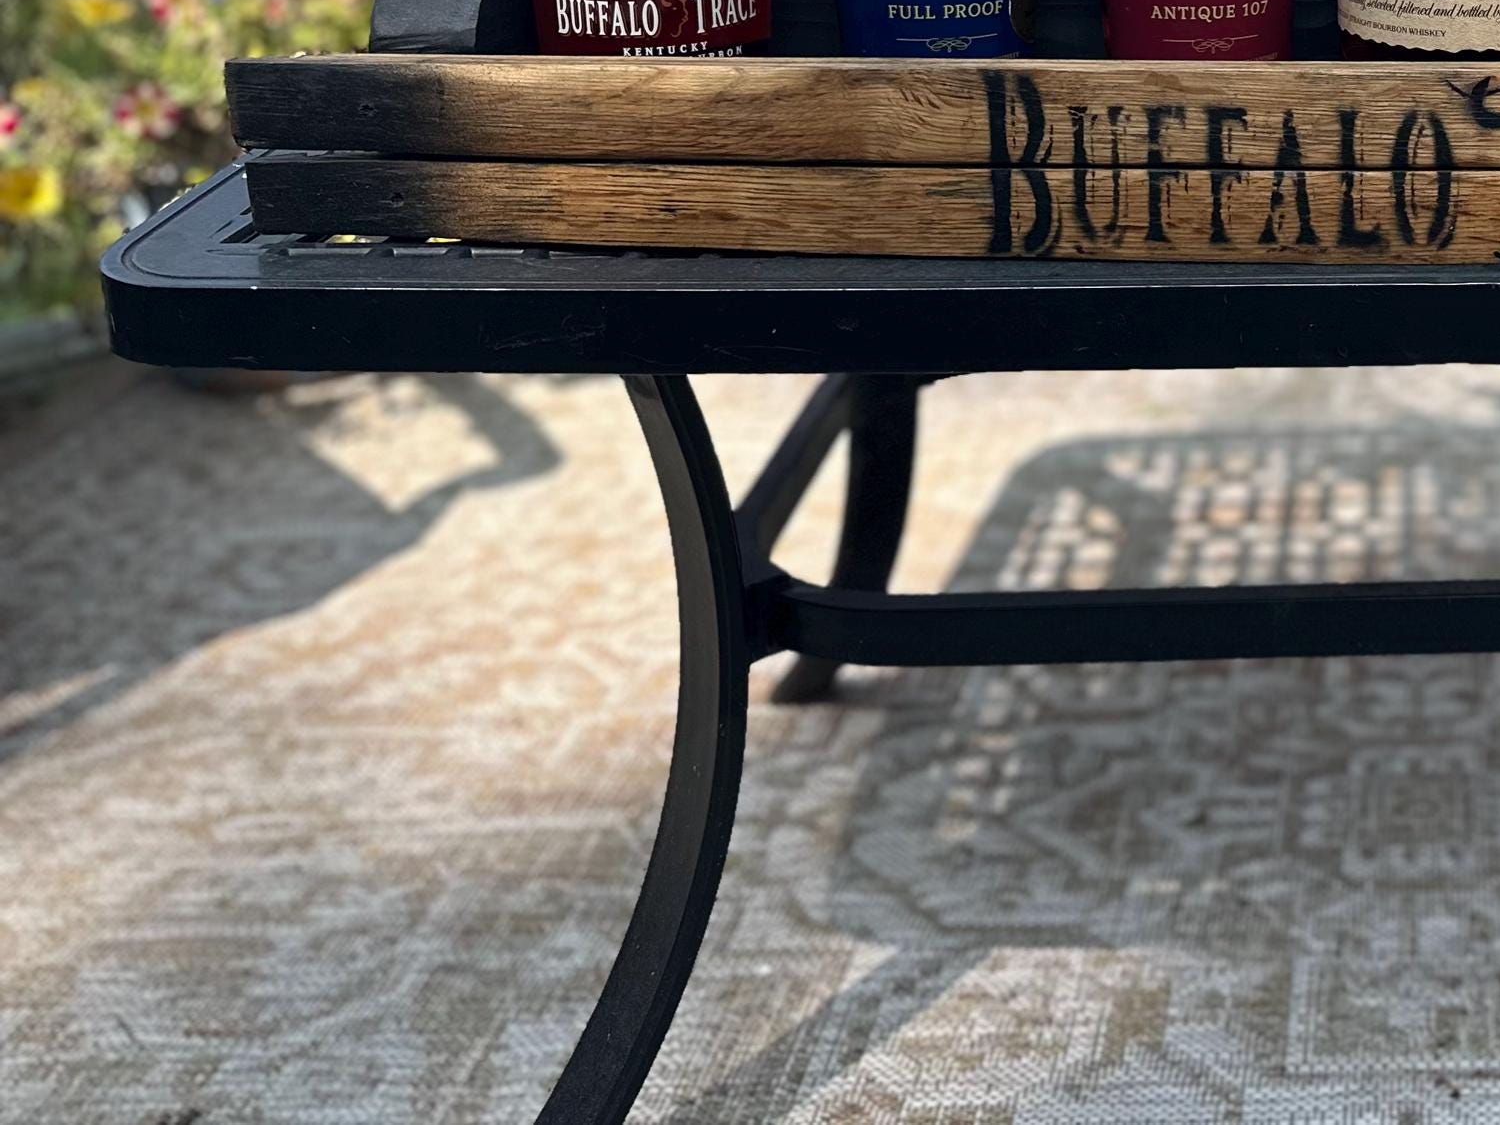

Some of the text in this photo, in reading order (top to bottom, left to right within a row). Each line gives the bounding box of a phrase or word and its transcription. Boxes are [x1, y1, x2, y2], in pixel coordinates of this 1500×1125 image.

[888, 0, 1004, 19] FULL PROOF
[1150, 0, 1269, 23] ANTIQUE 107
[1397, 0, 1434, 17] filtered
[1433, 3, 1457, 19] and
[1456, 3, 1493, 18] bottled
[1373, 22, 1407, 34] BOURBON
[1408, 27, 1447, 37] WHISKEY
[622, 41, 708, 57] KENTUCKY
[983, 70, 1460, 255] BUFFALO
